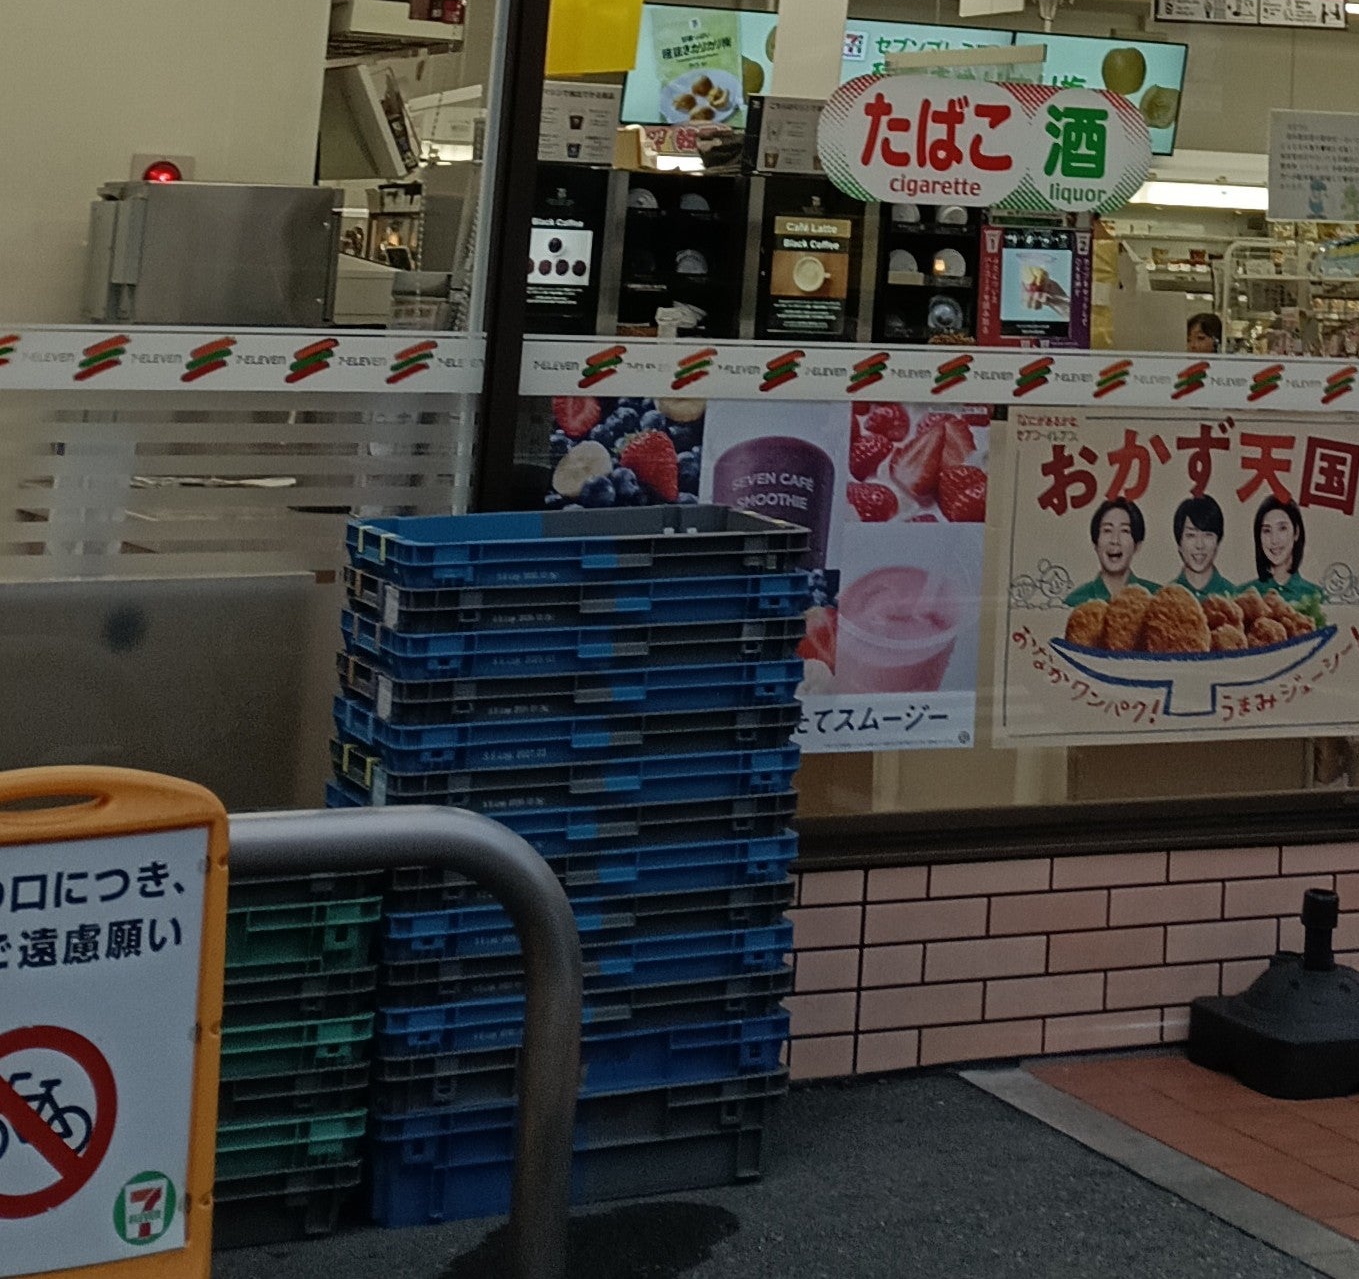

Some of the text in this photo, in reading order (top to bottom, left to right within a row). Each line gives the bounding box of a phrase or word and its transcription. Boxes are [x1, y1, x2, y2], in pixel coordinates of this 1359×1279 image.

[860, 92, 1108, 179] たばこ 酒
[889, 175, 1106, 204] cigarette liquor
[731, 471, 776, 491] SEVEN
[736, 491, 809, 510] SMOOTHIE
[0, 860, 186, 913] 口につき、
